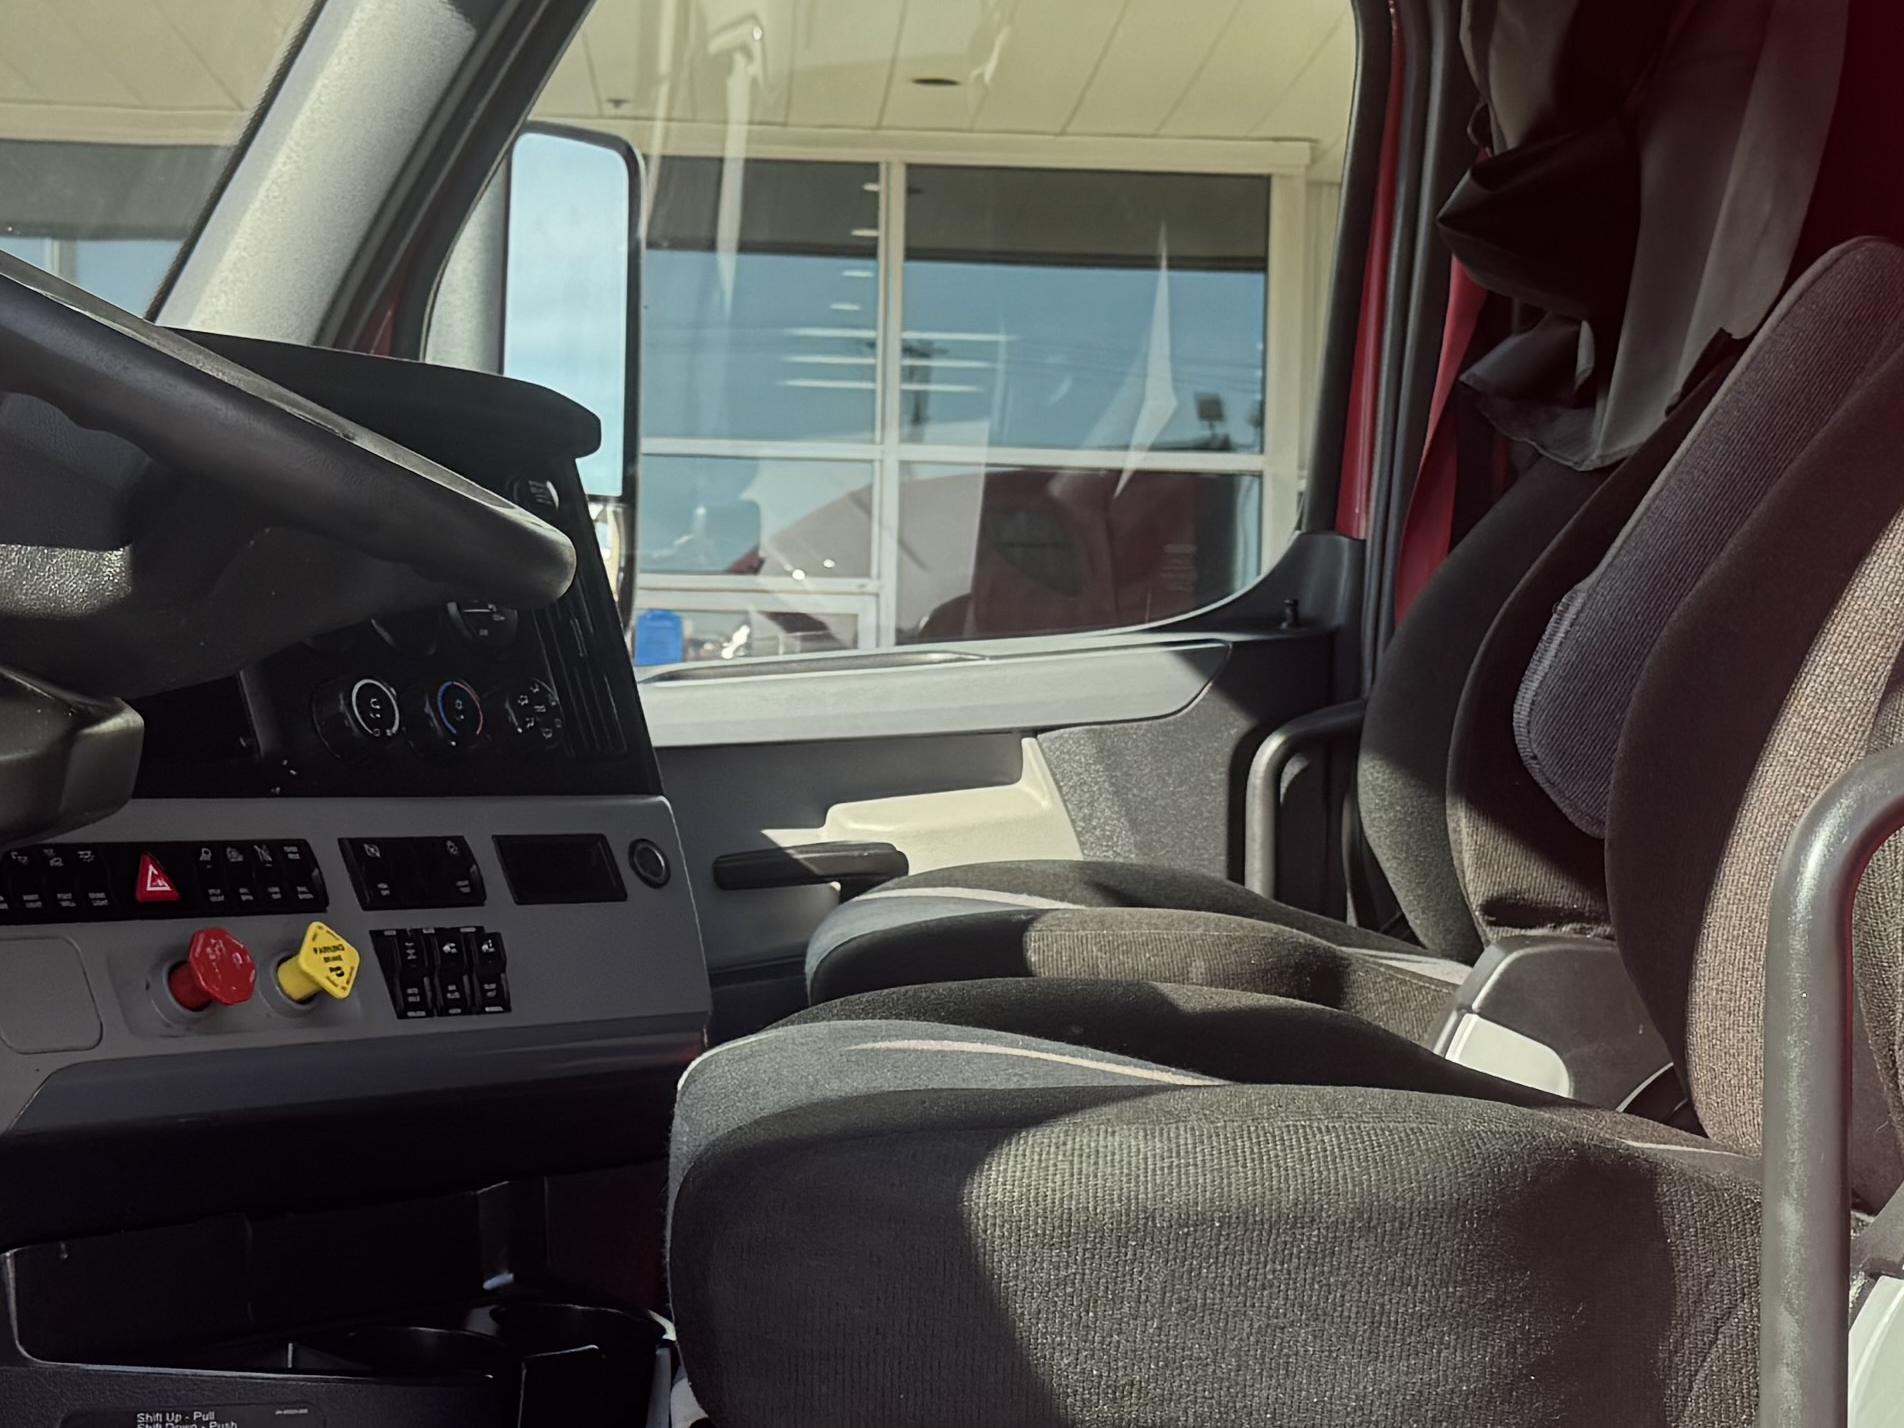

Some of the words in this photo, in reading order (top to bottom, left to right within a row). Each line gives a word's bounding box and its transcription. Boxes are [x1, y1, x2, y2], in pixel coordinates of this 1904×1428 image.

[136, 1412, 163, 1423] Shift
[165, 1412, 182, 1423] Up
[193, 1411, 215, 1421] Pull
